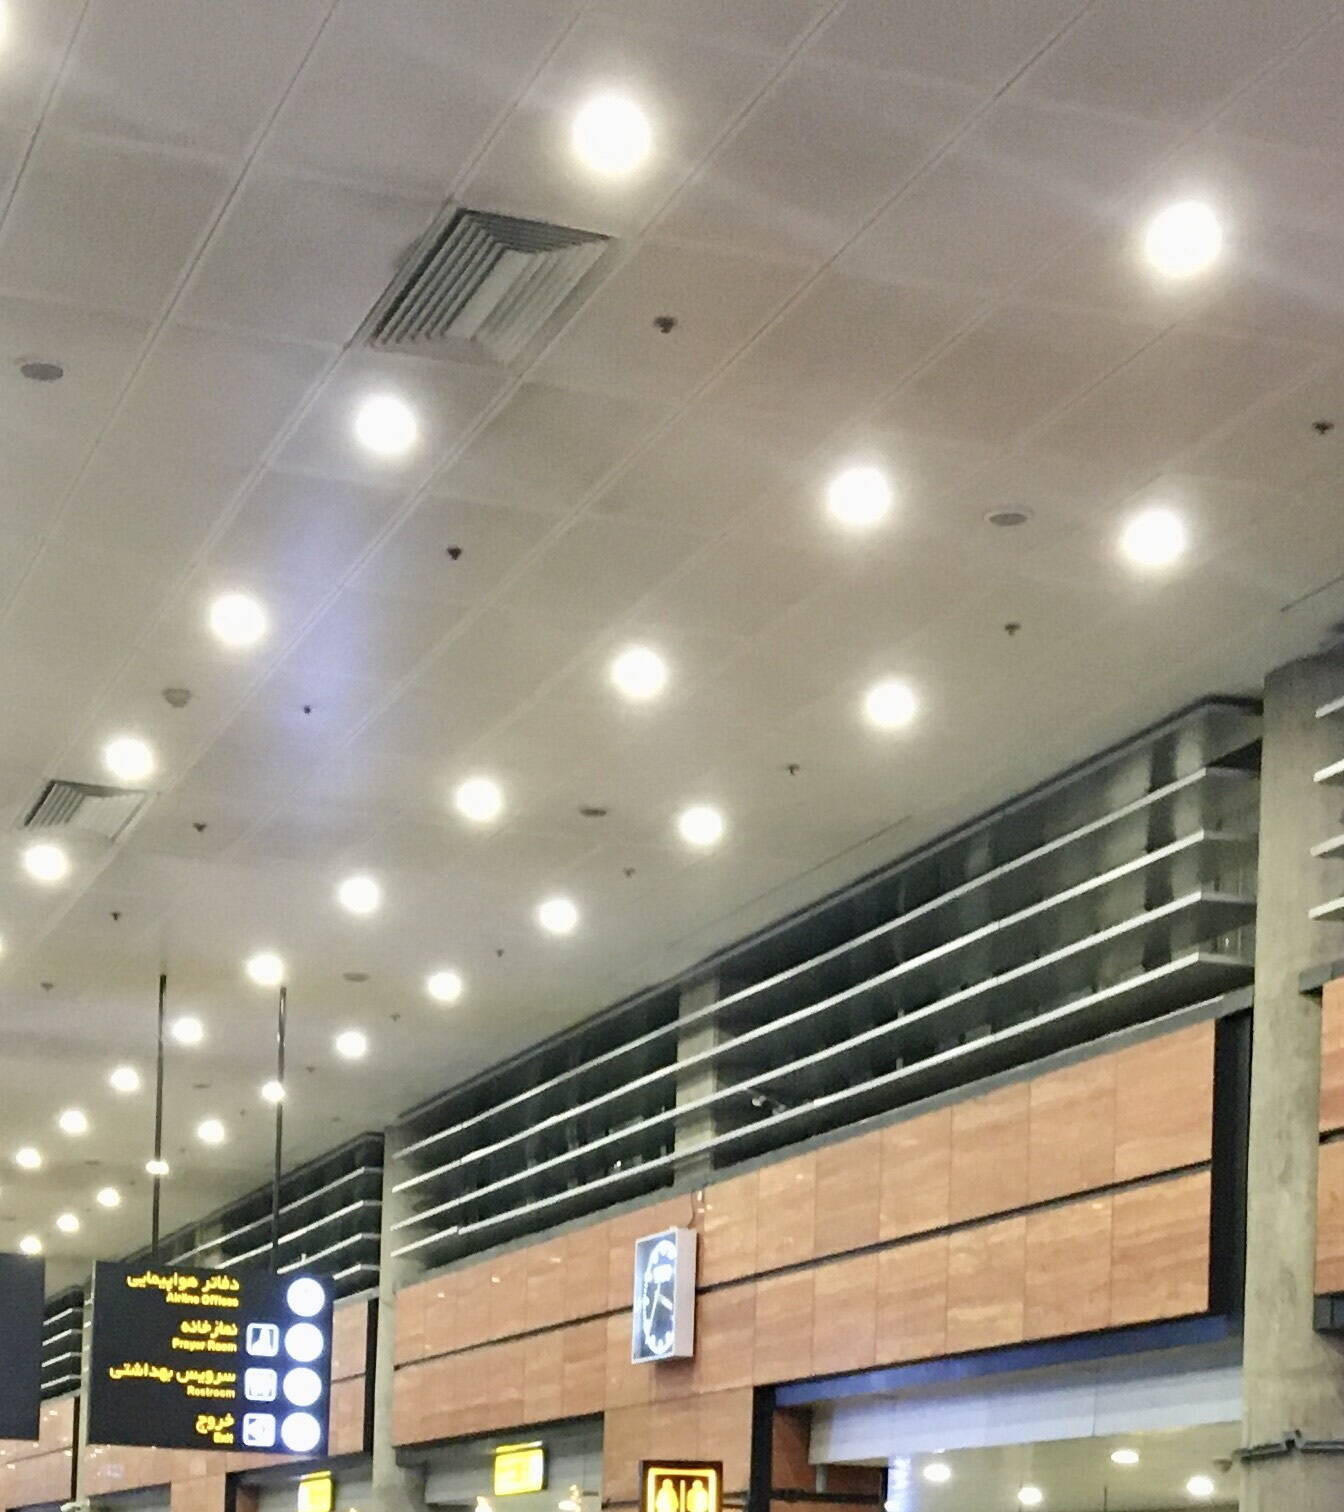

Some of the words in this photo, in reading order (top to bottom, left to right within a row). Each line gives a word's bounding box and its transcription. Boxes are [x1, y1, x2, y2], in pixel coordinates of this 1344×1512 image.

[201, 1275, 240, 1293] دفاتر
[201, 1294, 240, 1308] Offices
[171, 1337, 206, 1352] Prayer
[207, 1339, 238, 1353] Room
[109, 1361, 174, 1383] بهداشتی
[176, 1369, 237, 1386] سرویس
[186, 1385, 236, 1399] Restroom
[195, 1412, 235, 1435] خروج
